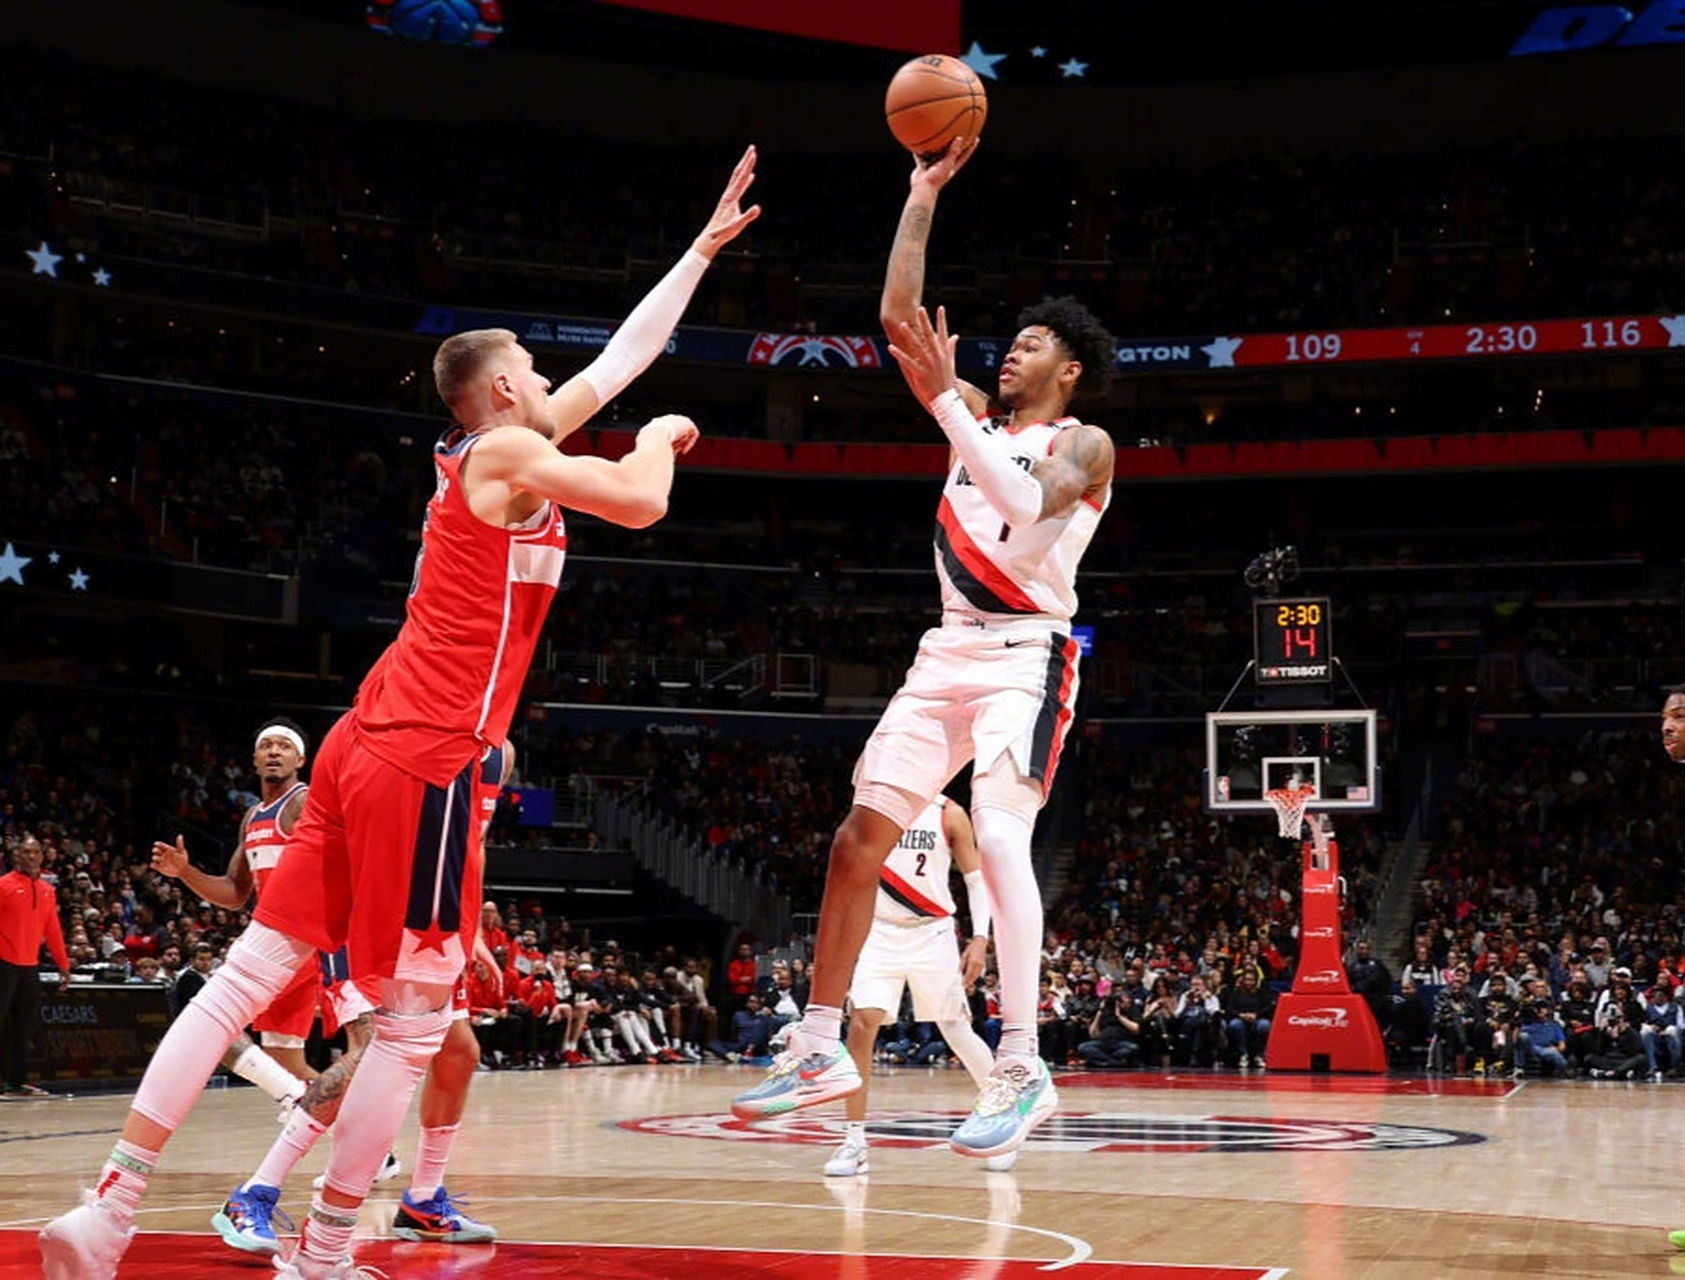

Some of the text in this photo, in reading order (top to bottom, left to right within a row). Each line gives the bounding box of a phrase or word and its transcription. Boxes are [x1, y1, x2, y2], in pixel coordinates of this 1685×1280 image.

[1466, 325, 1536, 354] 2:30
[1580, 320, 1642, 349] 116
[1285, 335, 1342, 361] 109
[1277, 604, 1321, 627] 2:30
[1284, 628, 1317, 659] 14
[914, 852, 927, 877] 2
[40, 1004, 99, 1024] CAESARS
